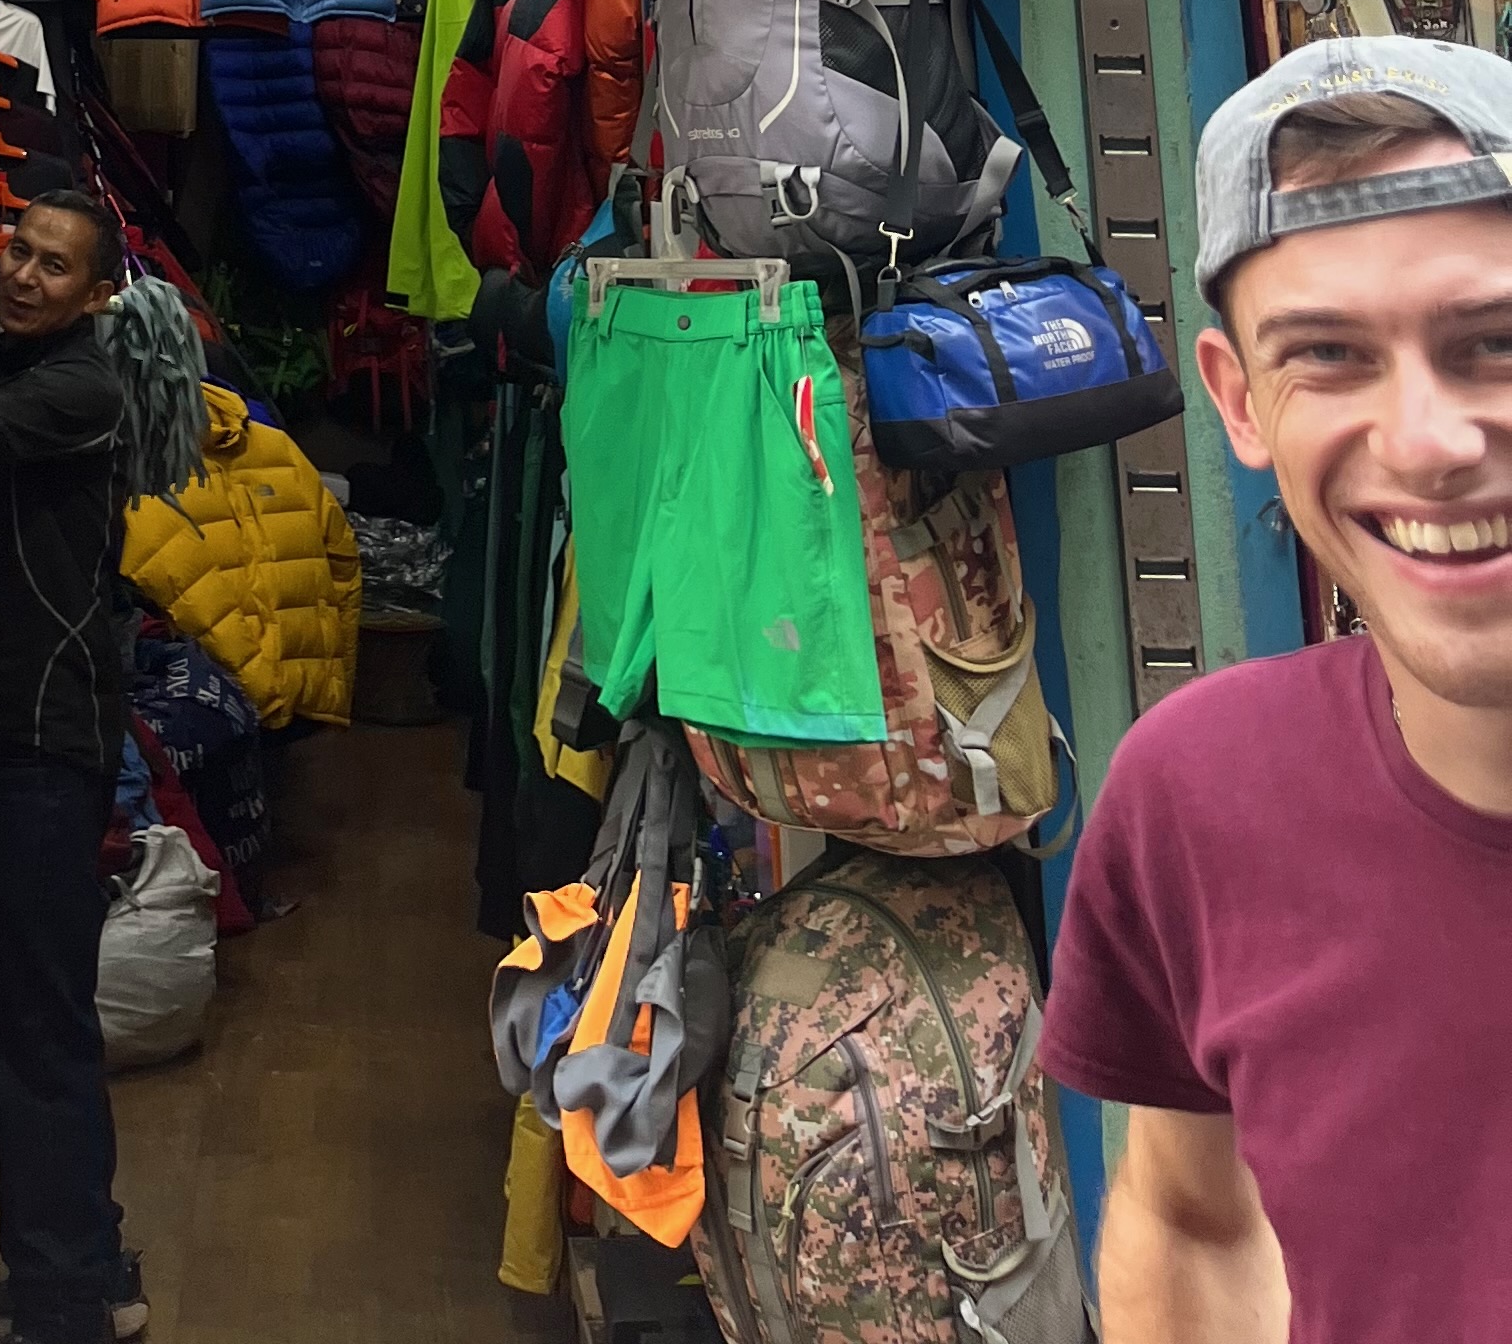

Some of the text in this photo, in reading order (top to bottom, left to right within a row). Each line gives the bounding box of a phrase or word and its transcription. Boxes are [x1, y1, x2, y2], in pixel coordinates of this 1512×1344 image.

[1319, 67, 1375, 91] JUST
[1041, 319, 1065, 332] THE
[1032, 329, 1070, 346] NORTH
[1047, 340, 1075, 356] FACE
[1043, 356, 1072, 370] WATER
